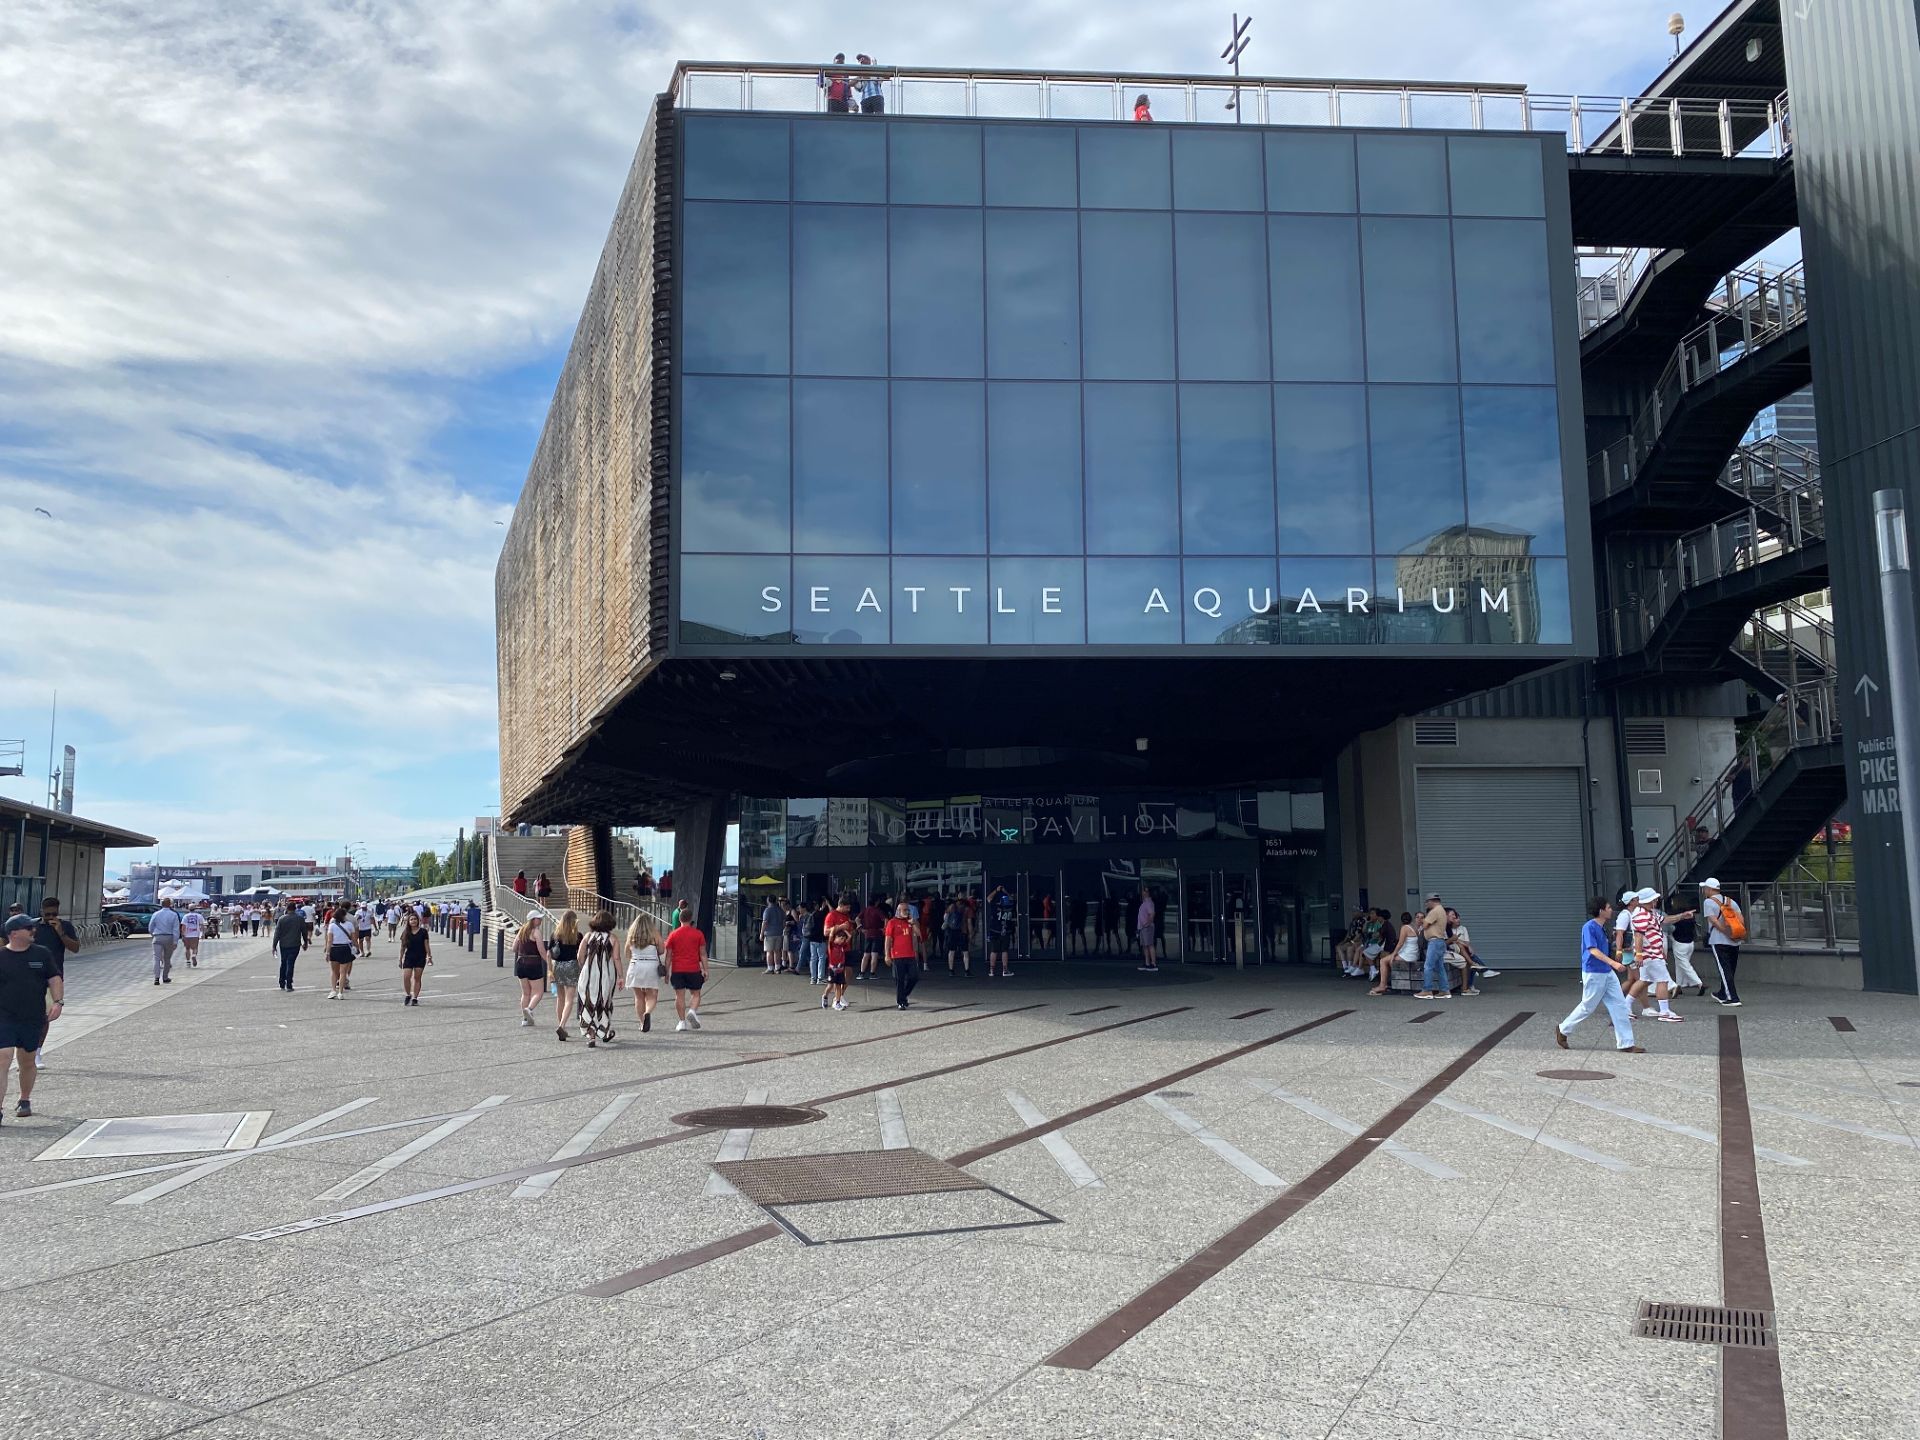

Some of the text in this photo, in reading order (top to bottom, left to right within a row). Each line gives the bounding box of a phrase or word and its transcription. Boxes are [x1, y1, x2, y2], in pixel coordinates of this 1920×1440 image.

[760, 586, 1510, 618] SEATTLE AQUARIUM
[1857, 738, 1886, 754] Public
[1859, 755, 1897, 785] PIKE
[1027, 796, 1096, 808] AQUARIUM
[1862, 787, 1901, 814] MAR
[887, 813, 1178, 839] OCEAN PAVILION
[1265, 838, 1282, 847] 1651
[1265, 848, 1318, 857] Alaskan Way
